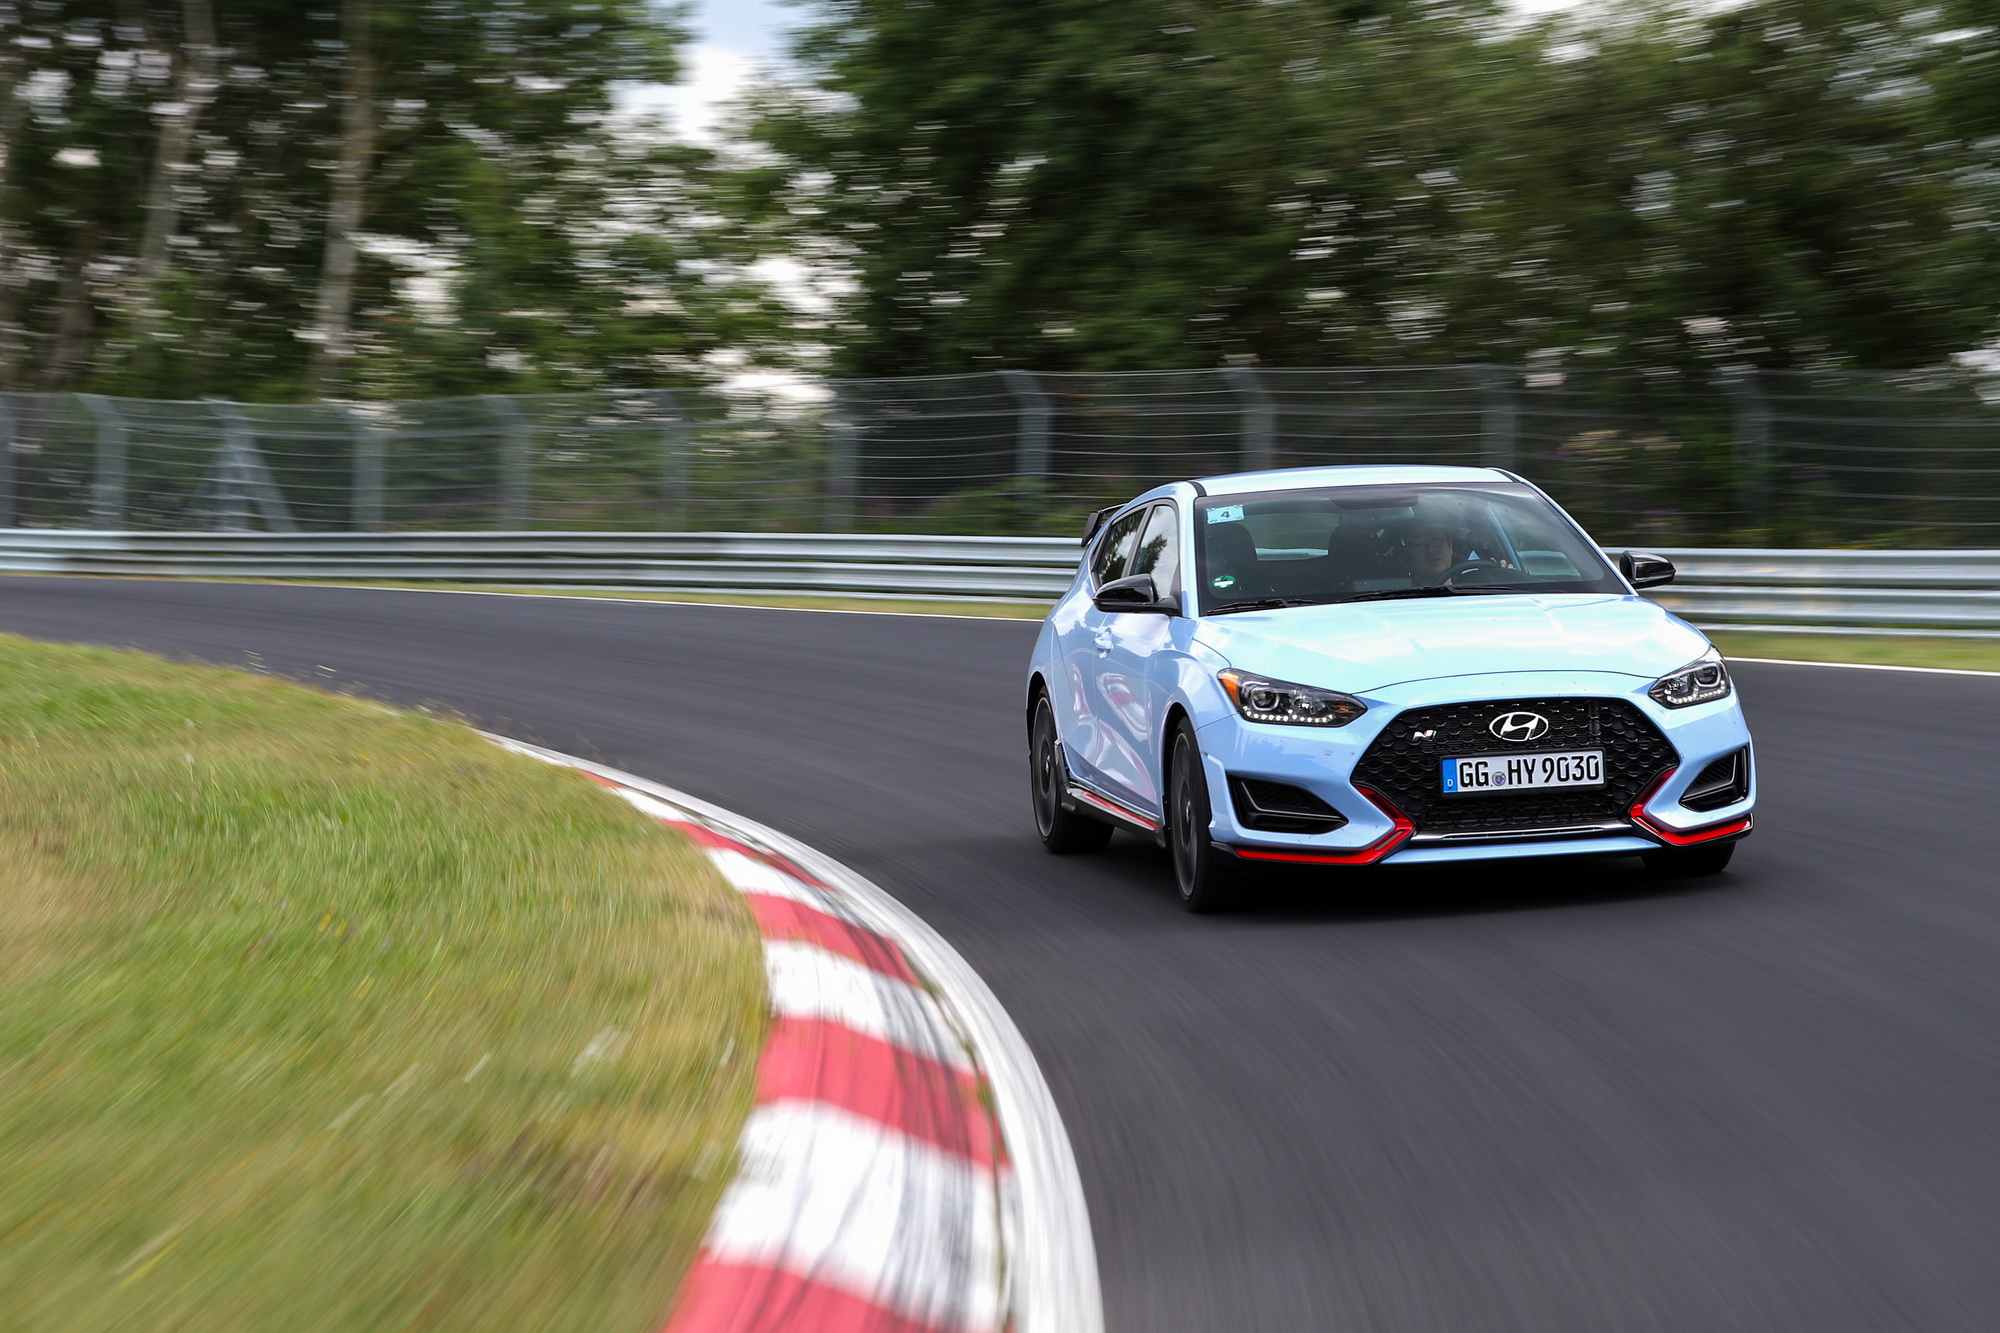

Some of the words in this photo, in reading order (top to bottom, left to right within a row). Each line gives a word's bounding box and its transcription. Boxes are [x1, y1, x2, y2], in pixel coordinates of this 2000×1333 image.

[1459, 761, 1489, 788] GG
[1507, 758, 1537, 785] HY
[1542, 755, 1600, 784] 9030
[1447, 778, 1454, 787] D
